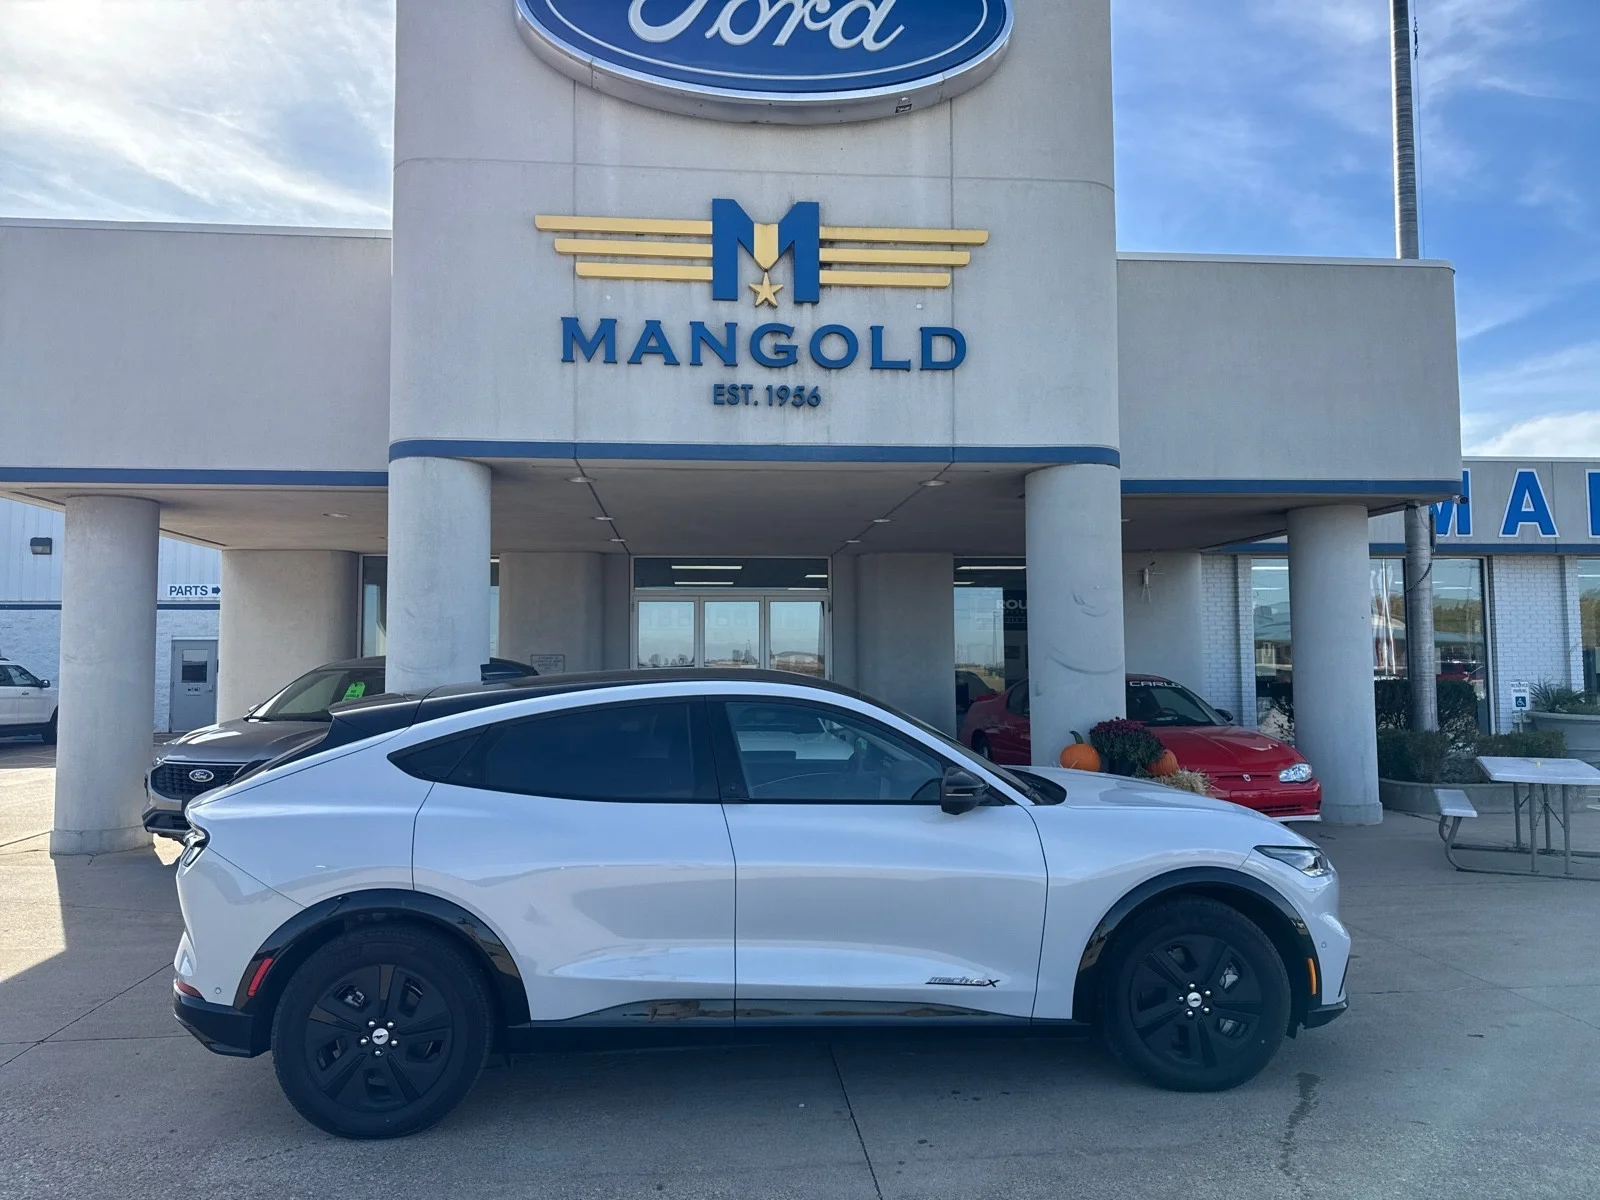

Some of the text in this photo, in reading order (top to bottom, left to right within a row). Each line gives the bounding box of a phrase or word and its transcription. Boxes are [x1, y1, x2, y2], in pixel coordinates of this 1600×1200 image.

[561, 317, 967, 372] MANGOLD
[713, 383, 821, 408] EST. 1956
[169, 585, 209, 596] PARTS
